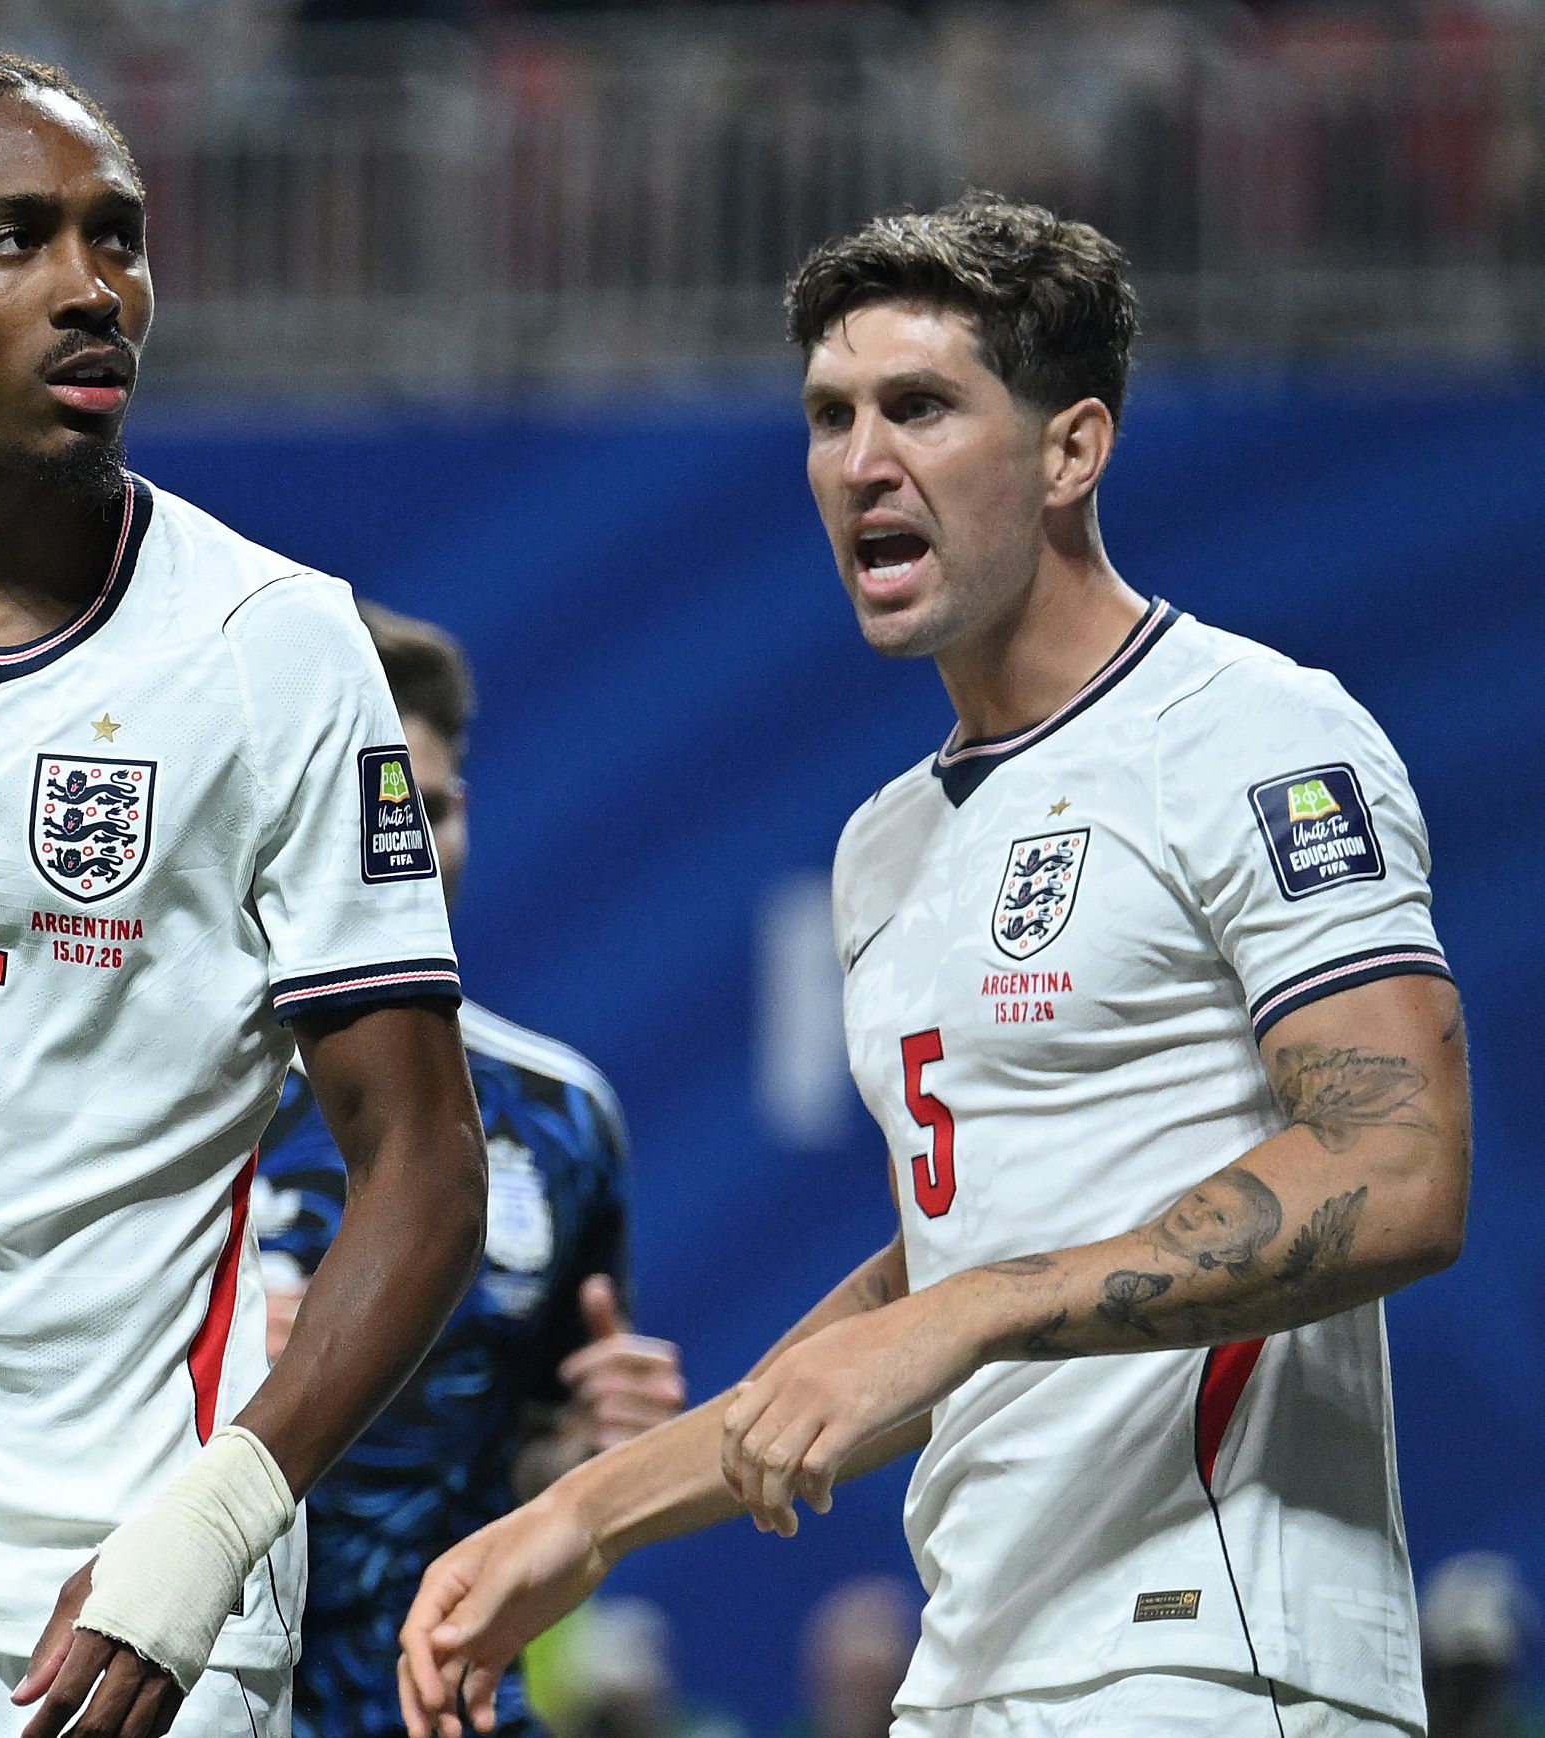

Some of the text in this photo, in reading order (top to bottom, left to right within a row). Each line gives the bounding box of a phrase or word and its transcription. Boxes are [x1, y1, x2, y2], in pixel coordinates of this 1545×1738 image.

[372, 830, 424, 854] EDUCATION
[1292, 814, 1350, 847] Unite For
[390, 854, 414, 867] FIFA
[1289, 835, 1367, 873] EDUCATION
[1319, 860, 1350, 878] FIFA
[31, 911, 144, 941] ARGENTINA
[52, 940, 123, 969] 15.07.26
[981, 971, 1073, 996] ARGENTINA
[995, 1001, 1055, 1024] 15.07.26
[900, 1026, 957, 1219] 5
